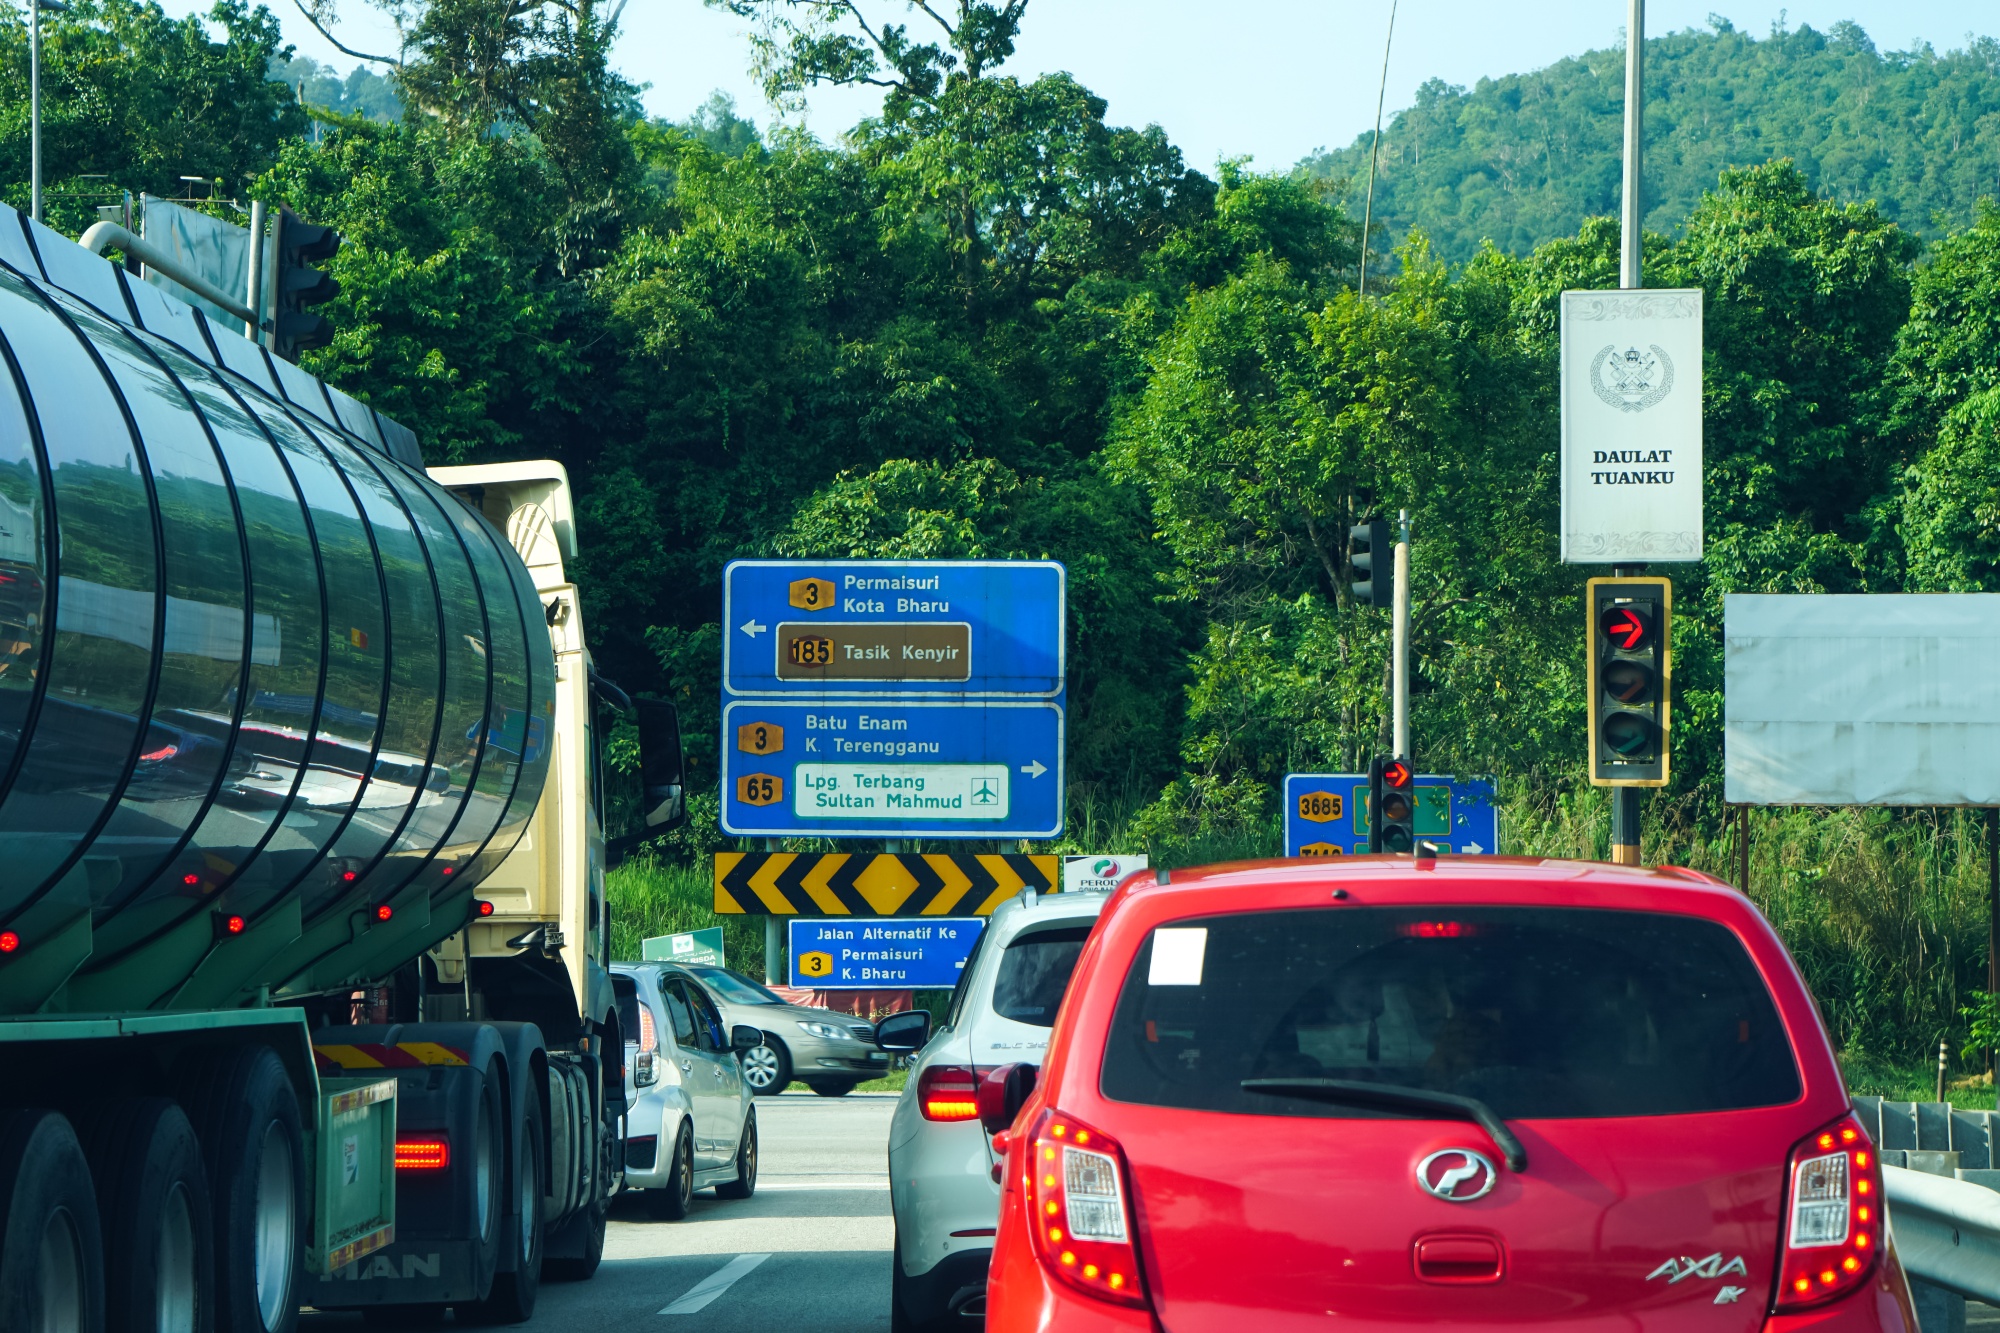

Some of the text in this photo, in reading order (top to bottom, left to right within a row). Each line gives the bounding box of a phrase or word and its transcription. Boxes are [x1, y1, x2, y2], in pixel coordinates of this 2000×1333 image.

[1592, 449, 1672, 464] DAULAT
[1590, 471, 1675, 485] TUANKU
[844, 575, 939, 590] Permaisuri
[806, 582, 818, 605] 3
[843, 598, 949, 613] Kota Bharu
[793, 640, 830, 663] 185
[844, 645, 959, 663] Tasik Kenyir
[805, 715, 908, 730] Batu Enam
[755, 727, 767, 750] 3
[805, 737, 940, 756] K. Terengganu
[746, 778, 774, 801] 65
[804, 773, 925, 791] Lpg. Terbang
[815, 793, 962, 809] Sultan Mahmud
[1301, 797, 1341, 816] 3685
[1080, 879, 1120, 887] PEROD
[816, 927, 957, 940] Jalan Alternatif Ke
[842, 948, 923, 961] Permaisuri
[810, 956, 822, 972] 3
[842, 967, 906, 980] K. Bharu
[1645, 1252, 1747, 1284] AXIA
